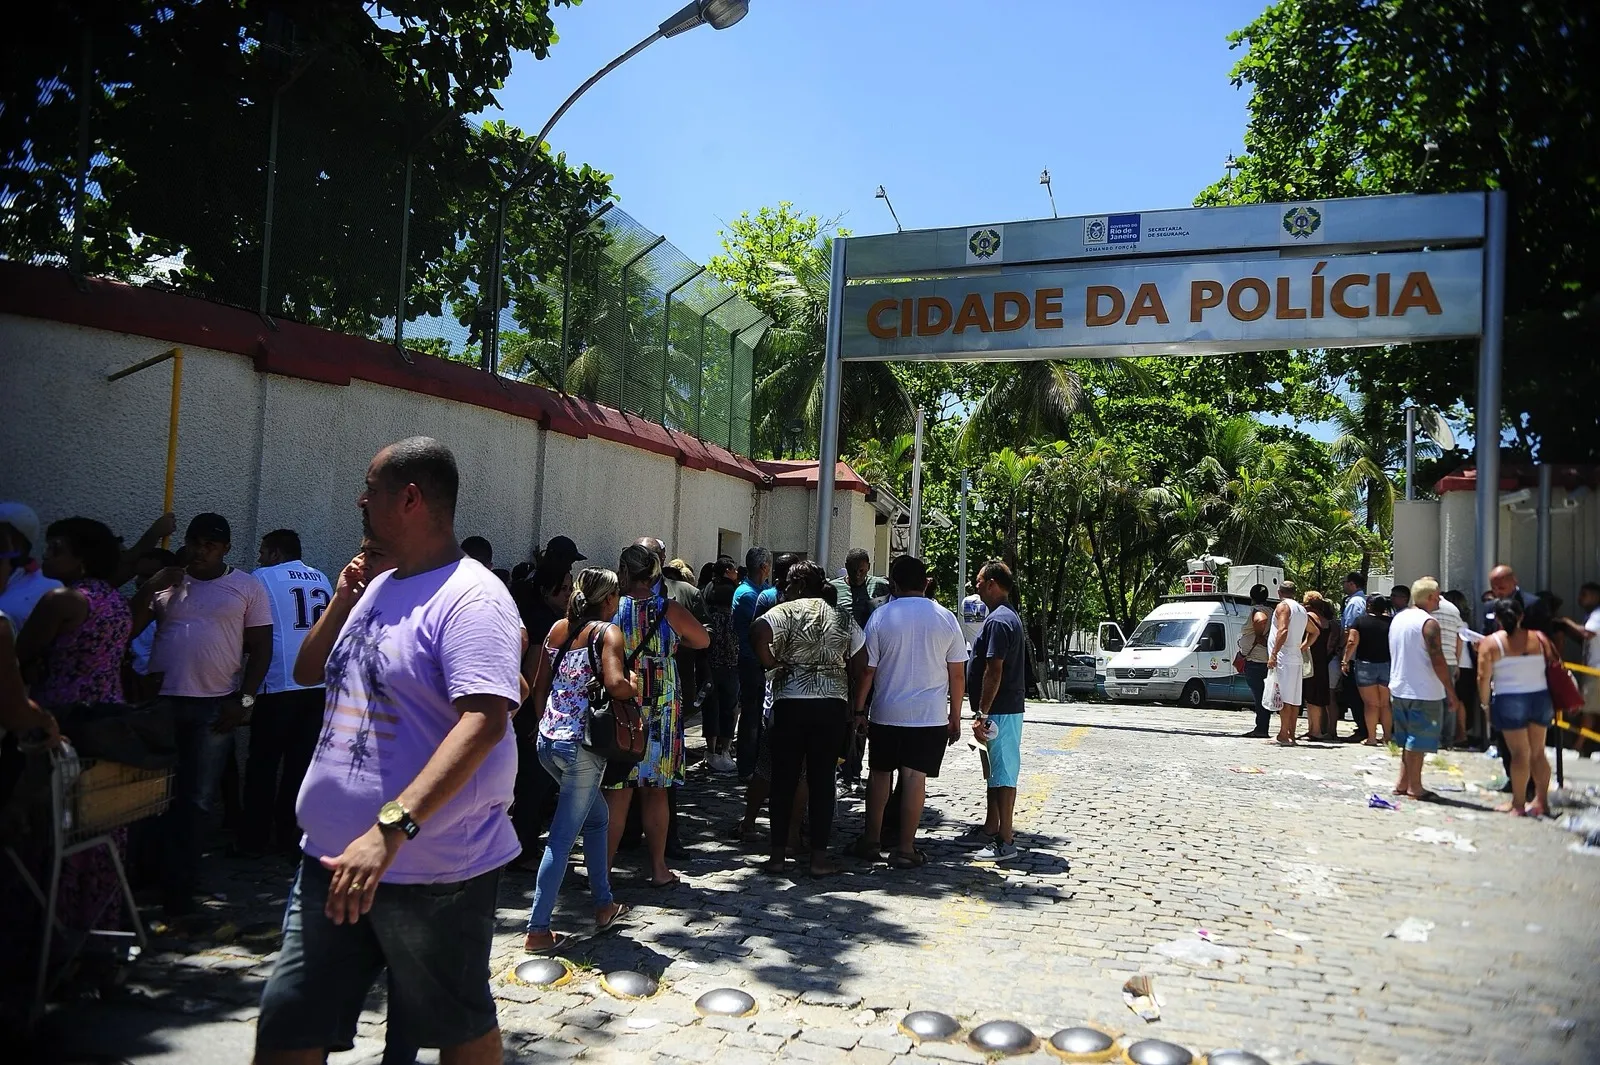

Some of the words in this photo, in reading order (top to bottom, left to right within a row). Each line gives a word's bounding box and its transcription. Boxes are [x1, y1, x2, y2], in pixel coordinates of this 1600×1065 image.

[867, 287, 1064, 339] CIDADE
[1086, 283, 1170, 328] DA
[1190, 261, 1443, 323] POLÍCIA
[288, 571, 322, 582] BRADY
[289, 587, 331, 630] 12
